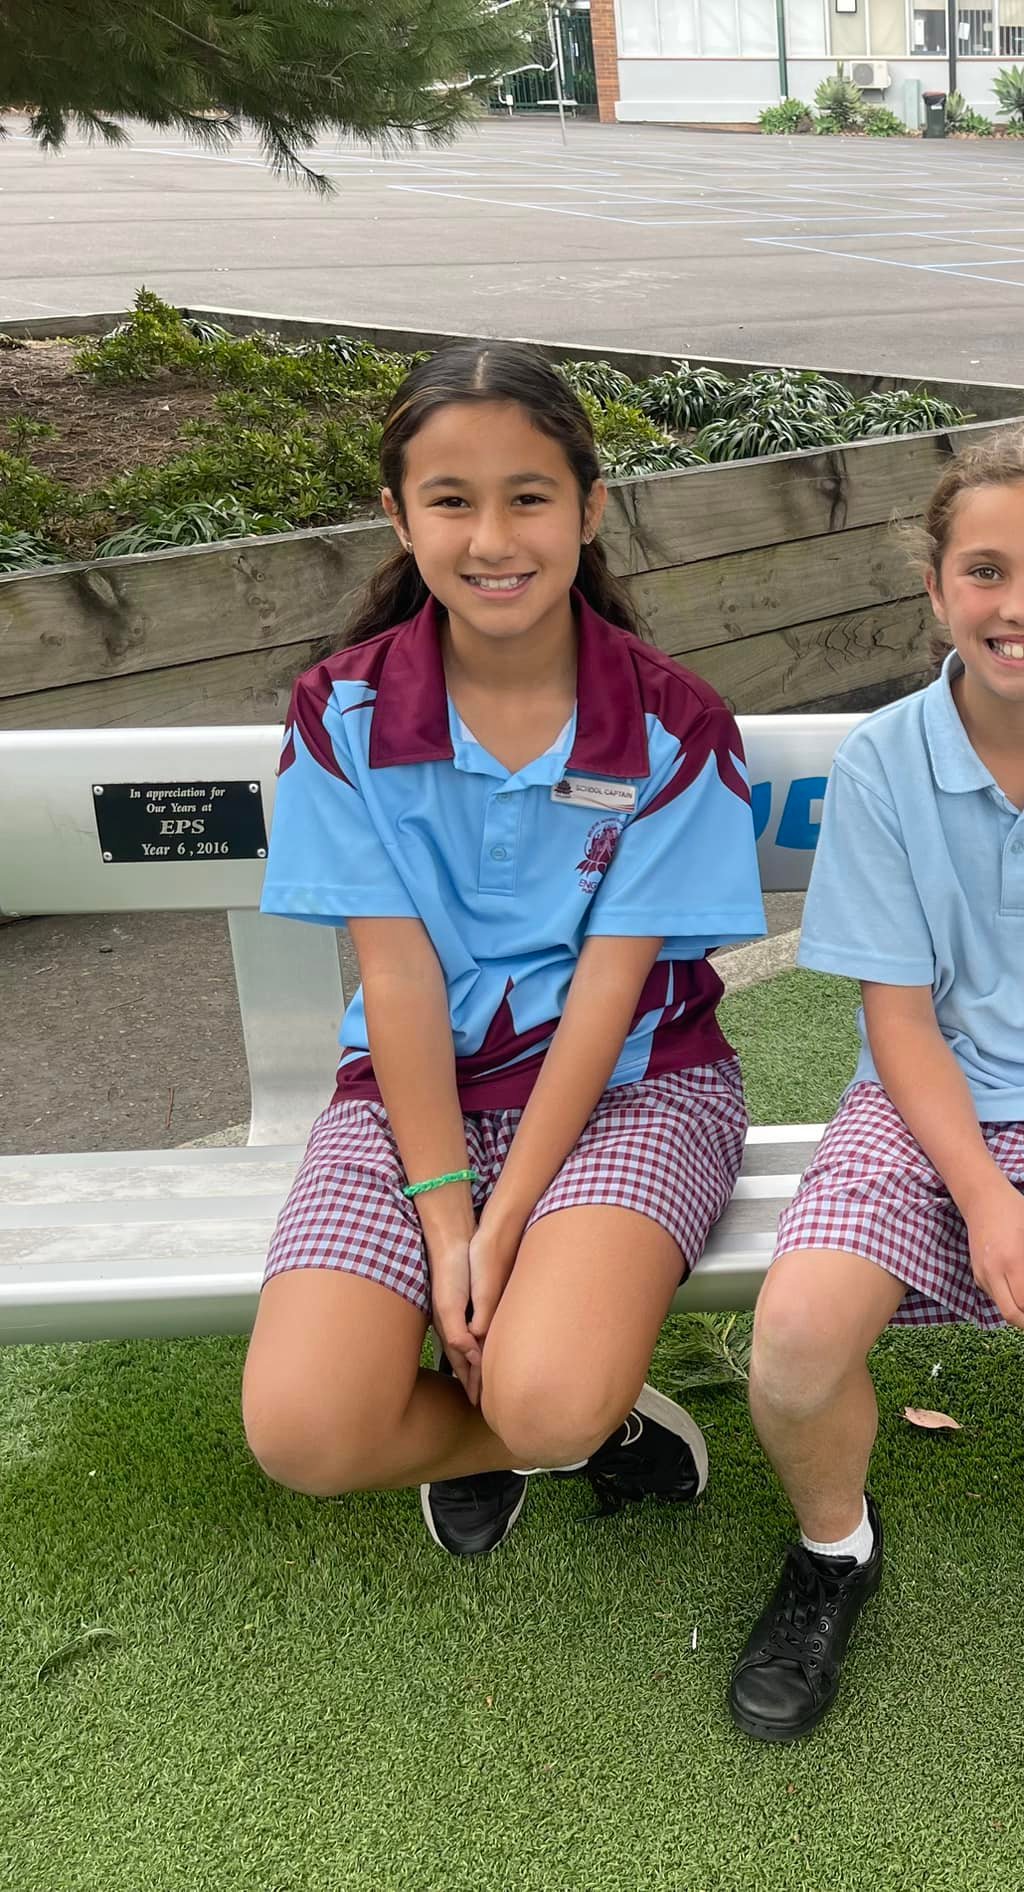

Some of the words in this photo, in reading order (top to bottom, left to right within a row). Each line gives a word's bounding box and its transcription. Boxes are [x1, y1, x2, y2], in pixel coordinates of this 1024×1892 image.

[130, 789, 141, 798] In
[146, 787, 206, 801] appreciation
[209, 787, 226, 800] for
[576, 784, 603, 794] SCHOOL
[604, 789, 632, 798] CAPTAIN
[146, 803, 166, 813] Our
[171, 803, 196, 813] Years
[201, 803, 212, 812] at
[160, 819, 205, 835] EPS
[141, 843, 170, 856] Year
